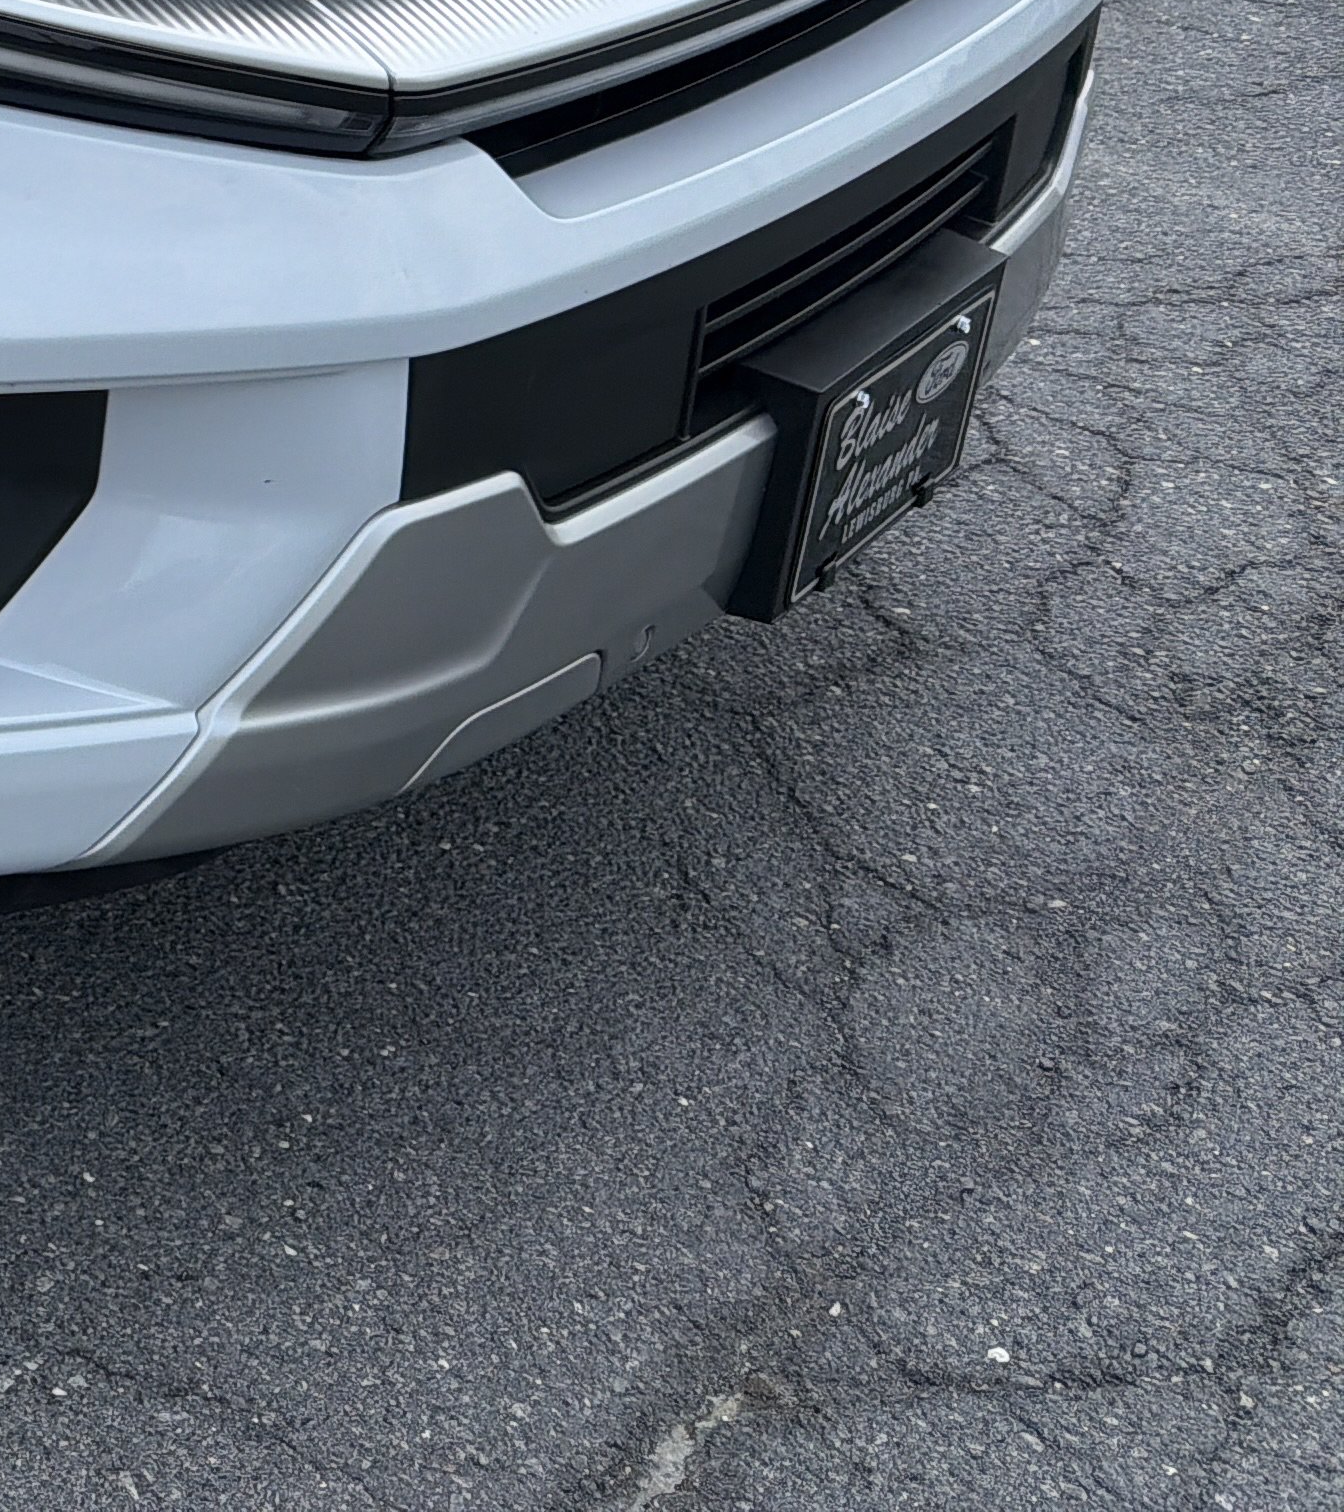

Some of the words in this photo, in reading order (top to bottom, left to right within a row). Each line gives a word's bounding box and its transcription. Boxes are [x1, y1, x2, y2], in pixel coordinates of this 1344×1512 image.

[836, 389, 913, 471] Blaise
[819, 412, 940, 541] Alexander
[841, 478, 905, 544] LEWISBURG
